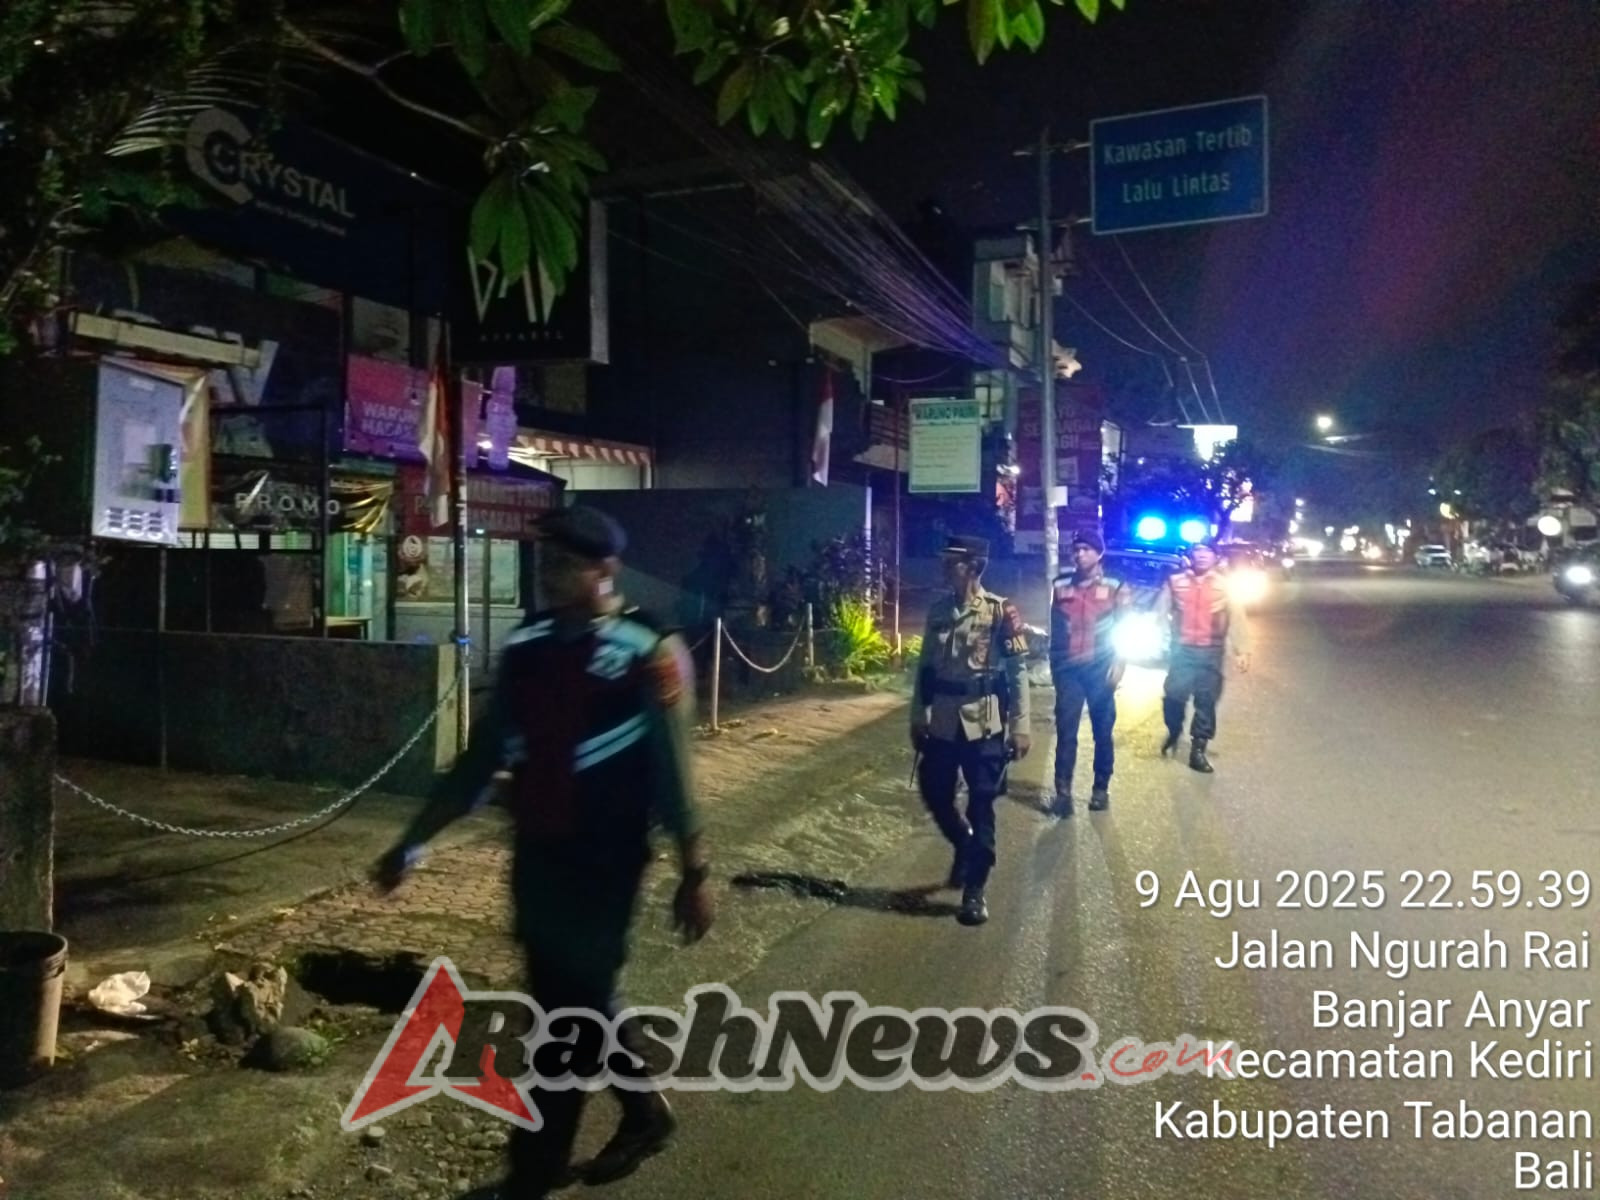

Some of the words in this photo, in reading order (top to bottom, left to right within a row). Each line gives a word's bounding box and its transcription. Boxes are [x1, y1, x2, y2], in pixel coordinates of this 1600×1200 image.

[1103, 137, 1187, 165] Kawasan
[1195, 124, 1252, 152] Tertib
[210, 143, 356, 219] CRYSTAL
[1122, 178, 1163, 203] Lalu
[1172, 172, 1231, 198] Lintas
[362, 401, 420, 424] WARUN
[234, 492, 341, 516] PROMO
